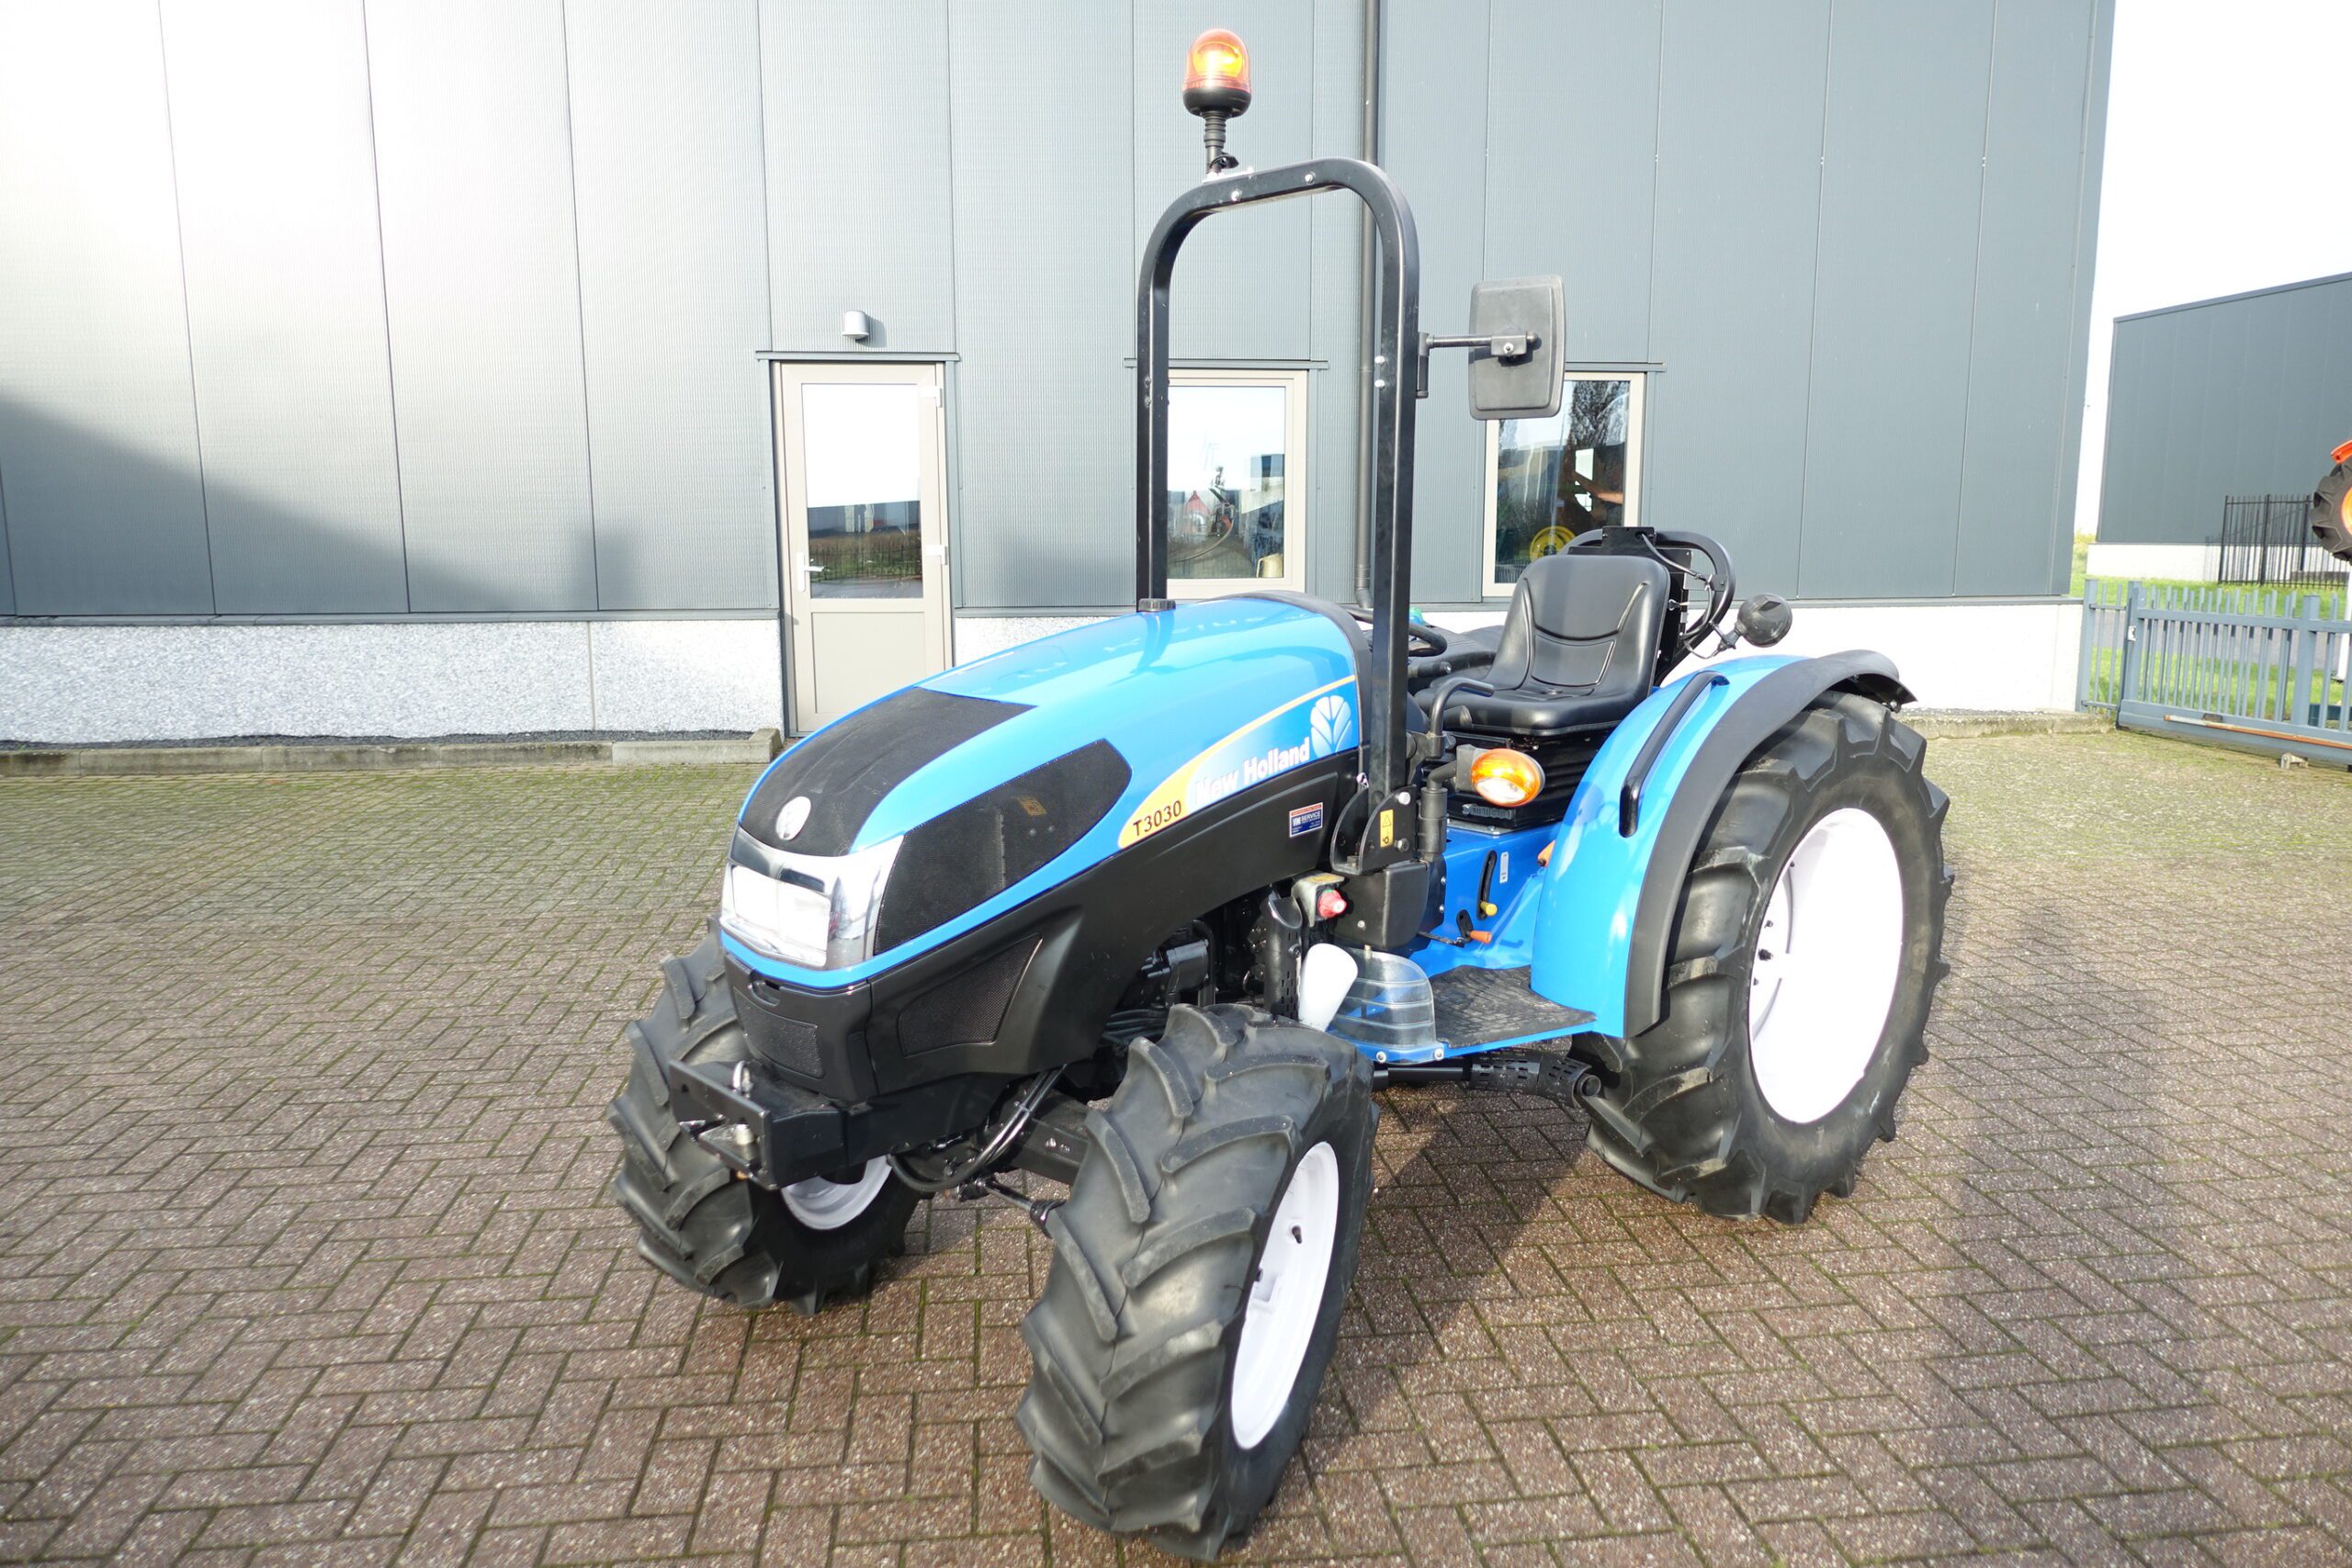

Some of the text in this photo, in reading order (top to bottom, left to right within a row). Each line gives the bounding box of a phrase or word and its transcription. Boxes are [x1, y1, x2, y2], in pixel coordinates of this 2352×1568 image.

[1195, 736, 1310, 805] New Holland
[1133, 800, 1182, 836] T3030
[1302, 810, 1321, 822] SERVICE
